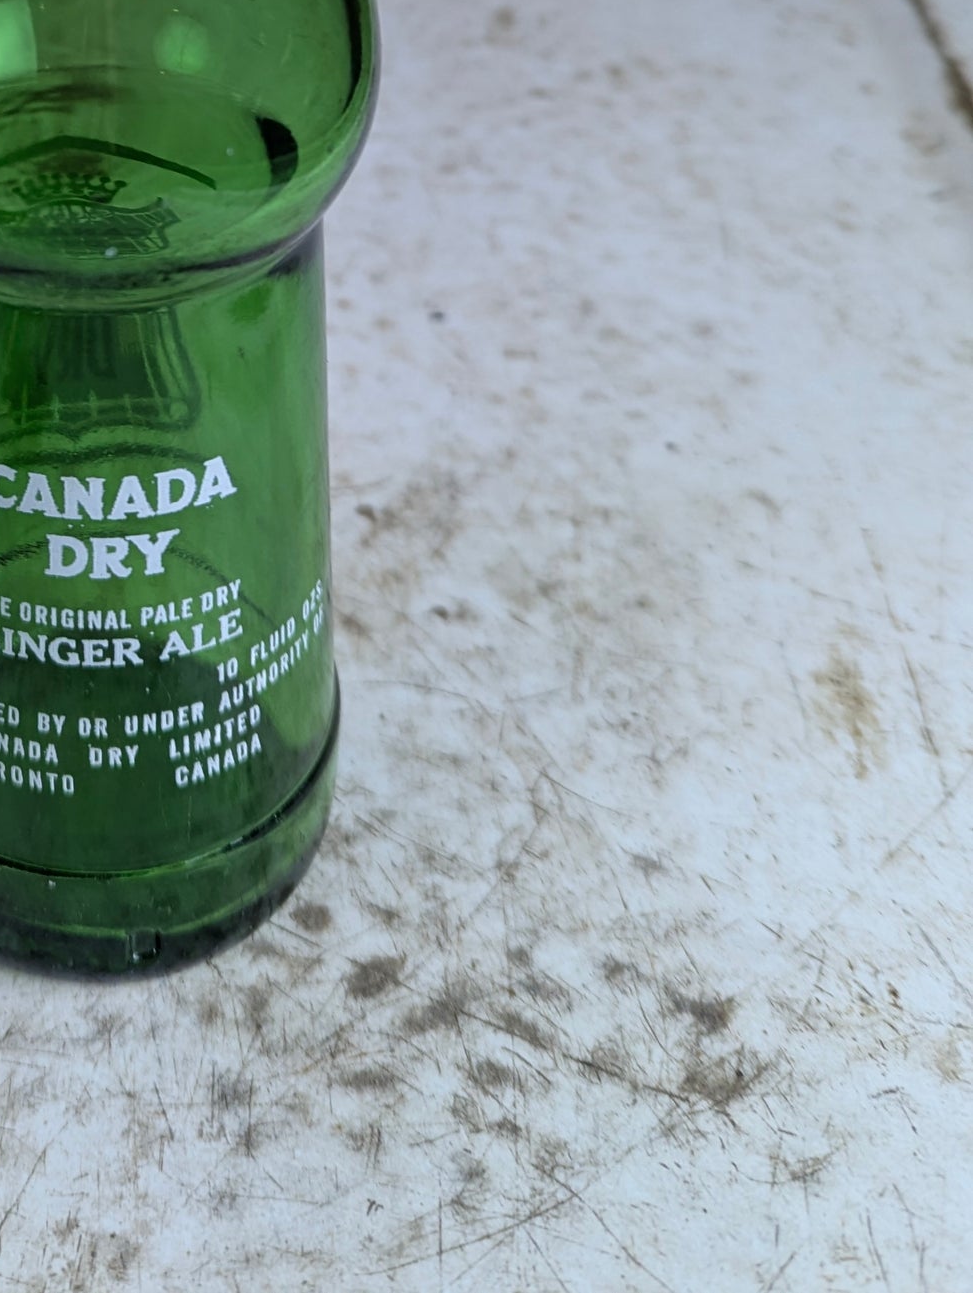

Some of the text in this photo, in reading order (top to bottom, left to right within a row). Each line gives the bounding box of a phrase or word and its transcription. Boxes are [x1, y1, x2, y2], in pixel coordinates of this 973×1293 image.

[44, 528, 181, 580] DRY
[19, 601, 132, 630] ORIGINAL
[140, 597, 193, 630] PALE
[199, 578, 241, 614] DRY
[158, 607, 244, 662] ALE
[216, 656, 239, 684] 10
[250, 616, 296, 668] FLUID
[37, 711, 66, 736] BY
[78, 716, 109, 739] OR
[124, 700, 205, 738] UNDER
[87, 743, 139, 769] DRY
[168, 704, 261, 761] LIMITED
[174, 732, 262, 788] CANADA
